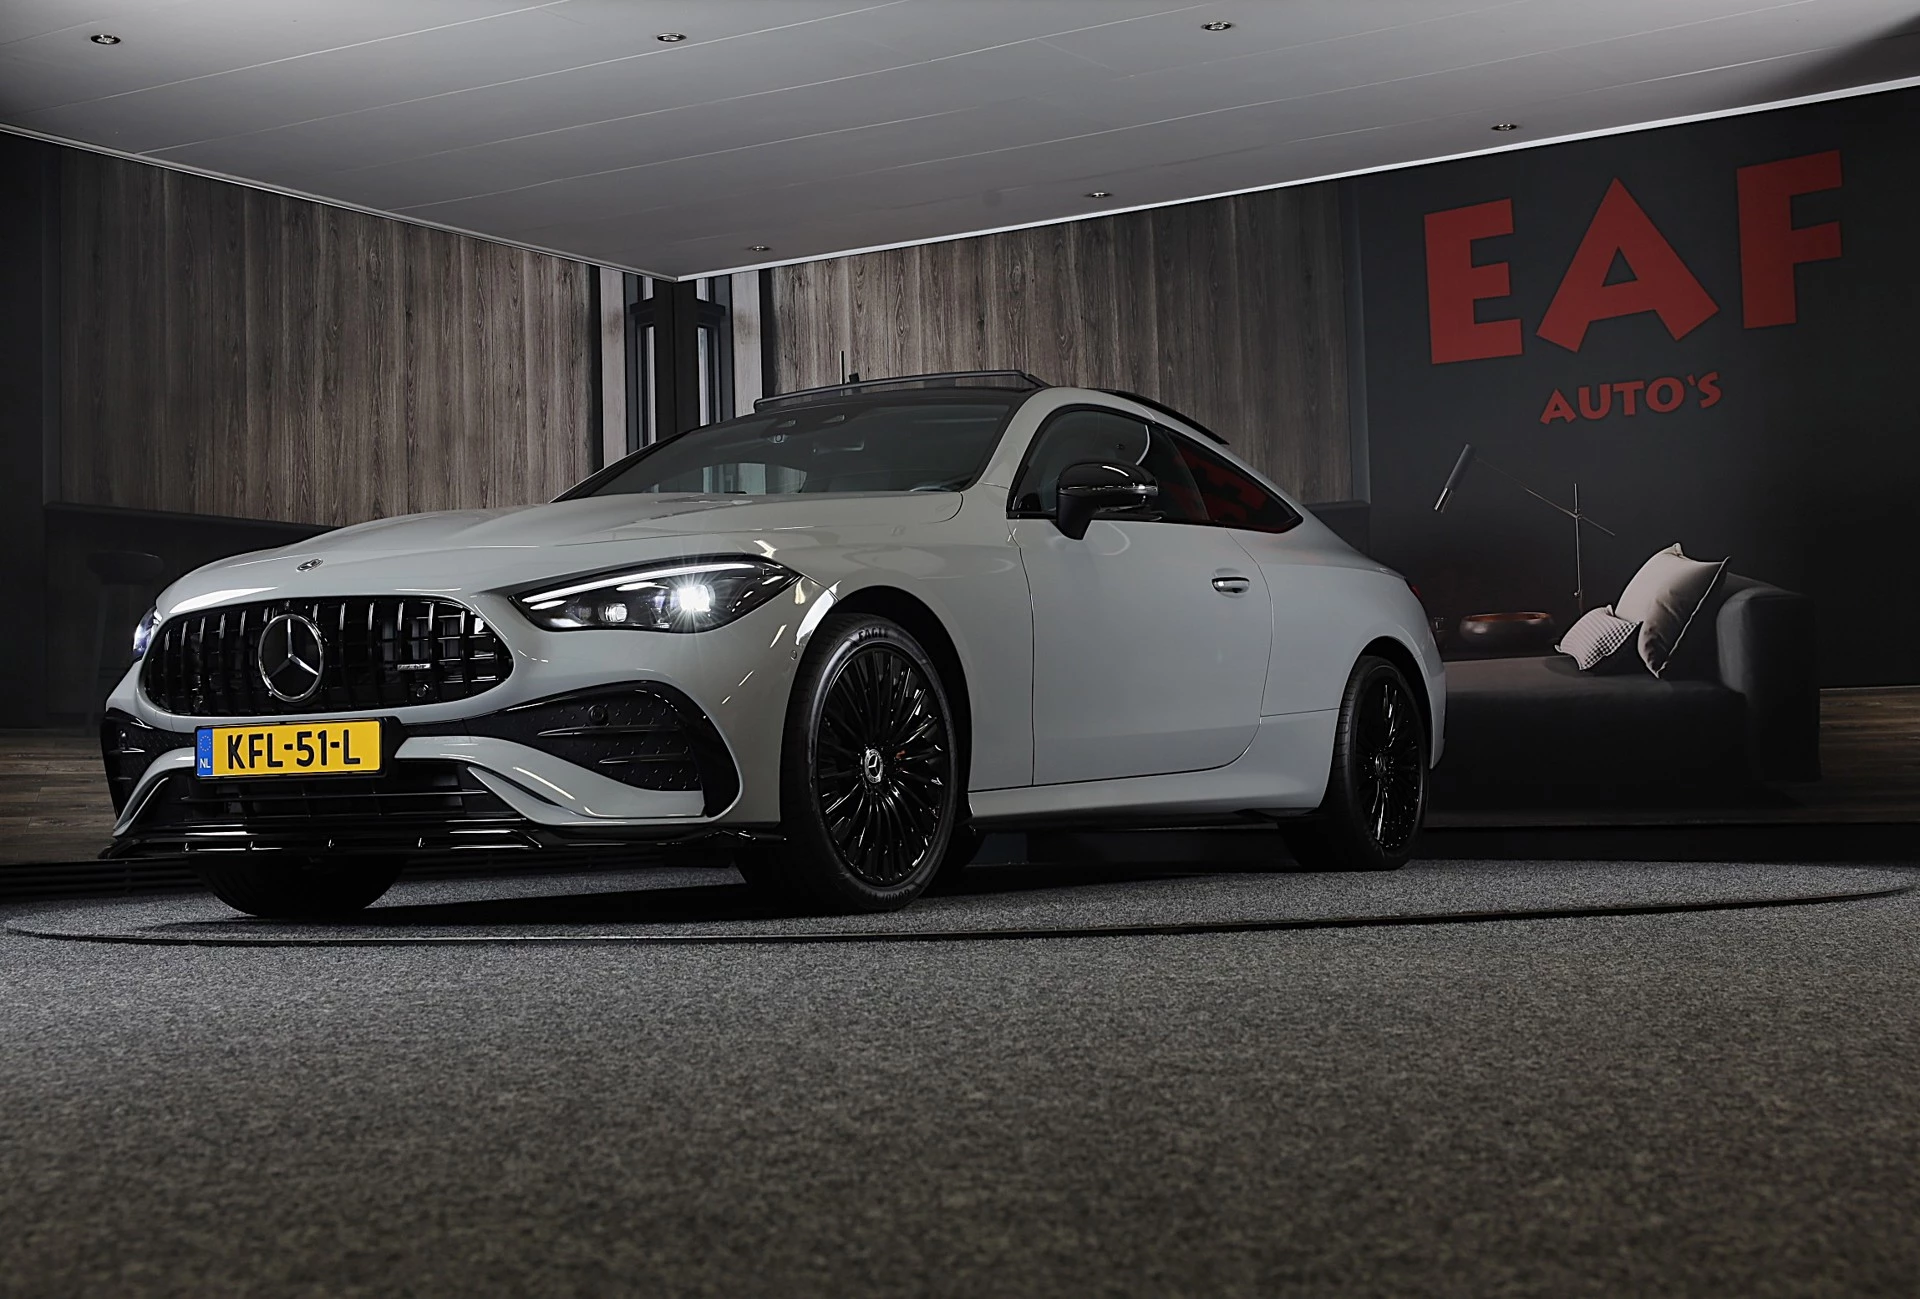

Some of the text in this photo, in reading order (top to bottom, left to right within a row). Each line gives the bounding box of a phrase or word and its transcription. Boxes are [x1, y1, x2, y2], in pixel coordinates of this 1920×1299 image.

[1424, 150, 1842, 364] EAF
[1540, 372, 1721, 424] AUTO'S
[200, 758, 211, 769] NL
[228, 729, 360, 769] KFL-51-L
